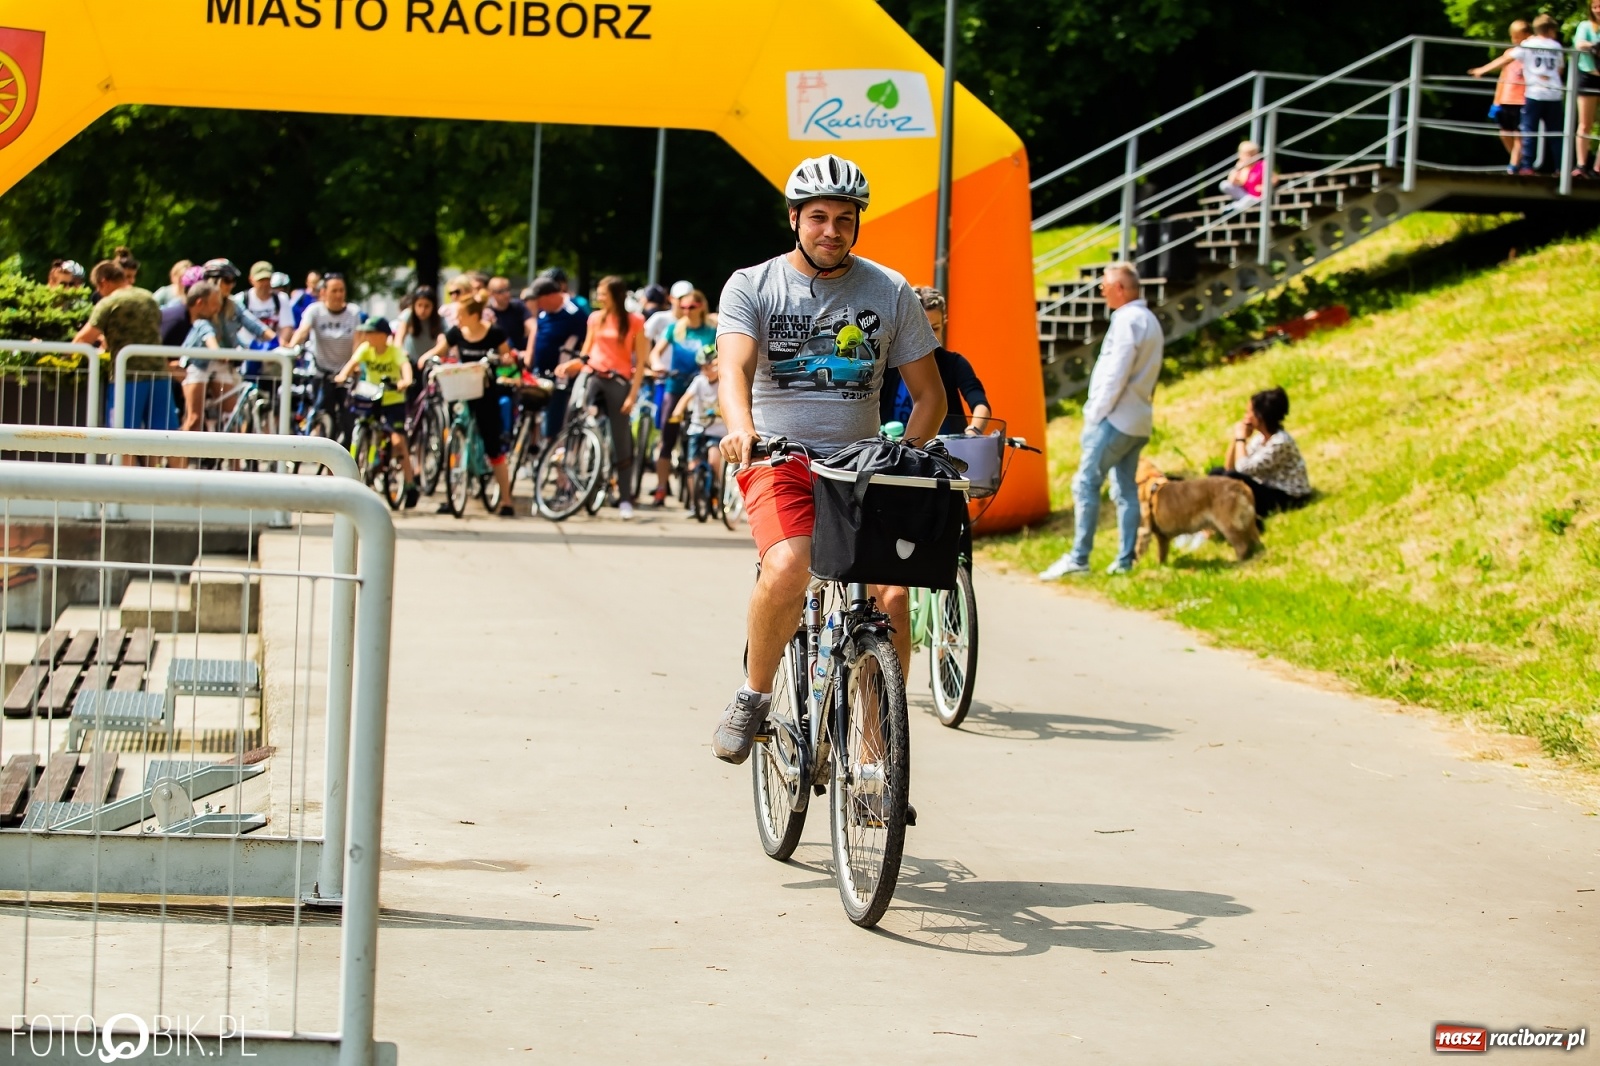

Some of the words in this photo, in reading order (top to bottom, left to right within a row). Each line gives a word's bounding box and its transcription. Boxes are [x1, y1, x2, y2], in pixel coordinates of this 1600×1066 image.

[206, 0, 388, 32] MIASTO
[770, 314, 800, 323] DRIVE
[802, 315, 812, 323] IT
[769, 323, 790, 331] LIKE
[790, 323, 811, 331] YOU
[768, 331, 798, 339] STOLE
[800, 331, 810, 339] IT
